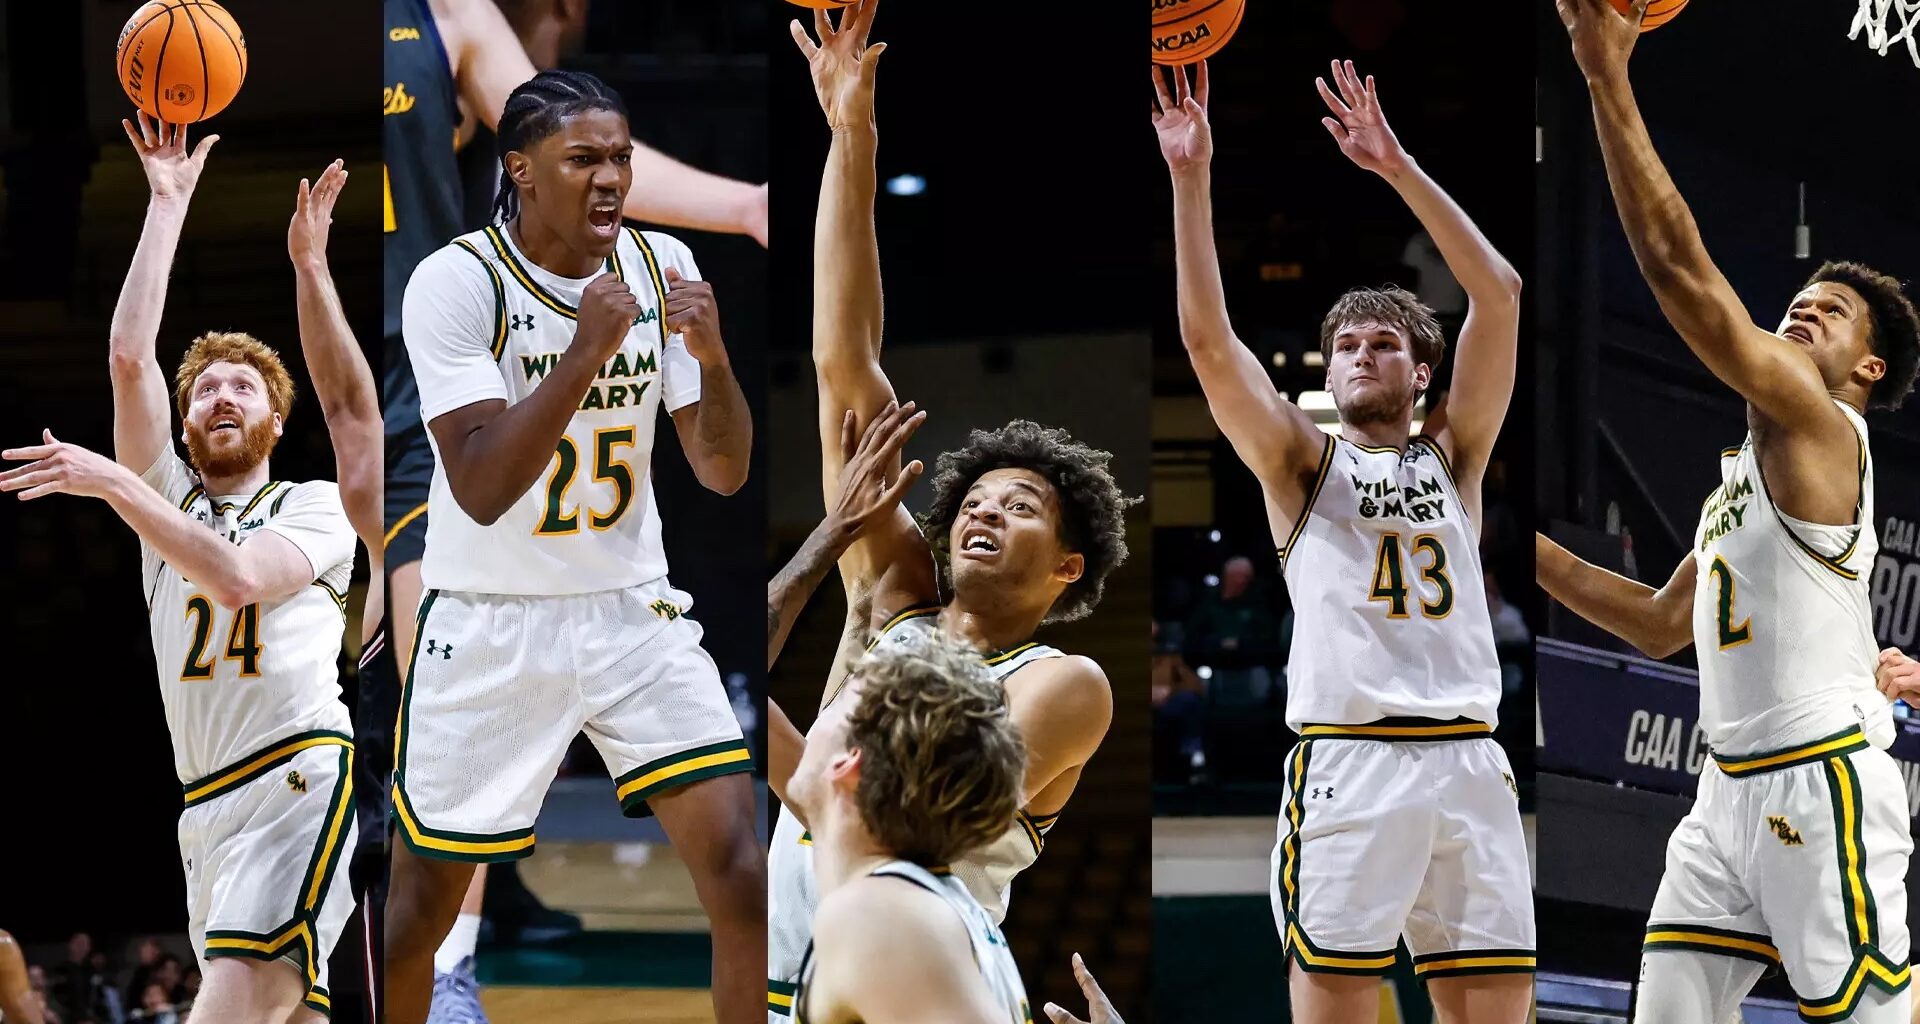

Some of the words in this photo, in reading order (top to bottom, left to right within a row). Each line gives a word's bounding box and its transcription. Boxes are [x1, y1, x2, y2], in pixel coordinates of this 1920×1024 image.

[576, 380, 652, 411] ARY
[532, 425, 636, 536] 25
[1359, 496, 1379, 518] &
[1368, 532, 1455, 620] 43
[1710, 554, 1754, 652] 2
[180, 594, 264, 682] 24
[1625, 709, 1683, 771] CAA
